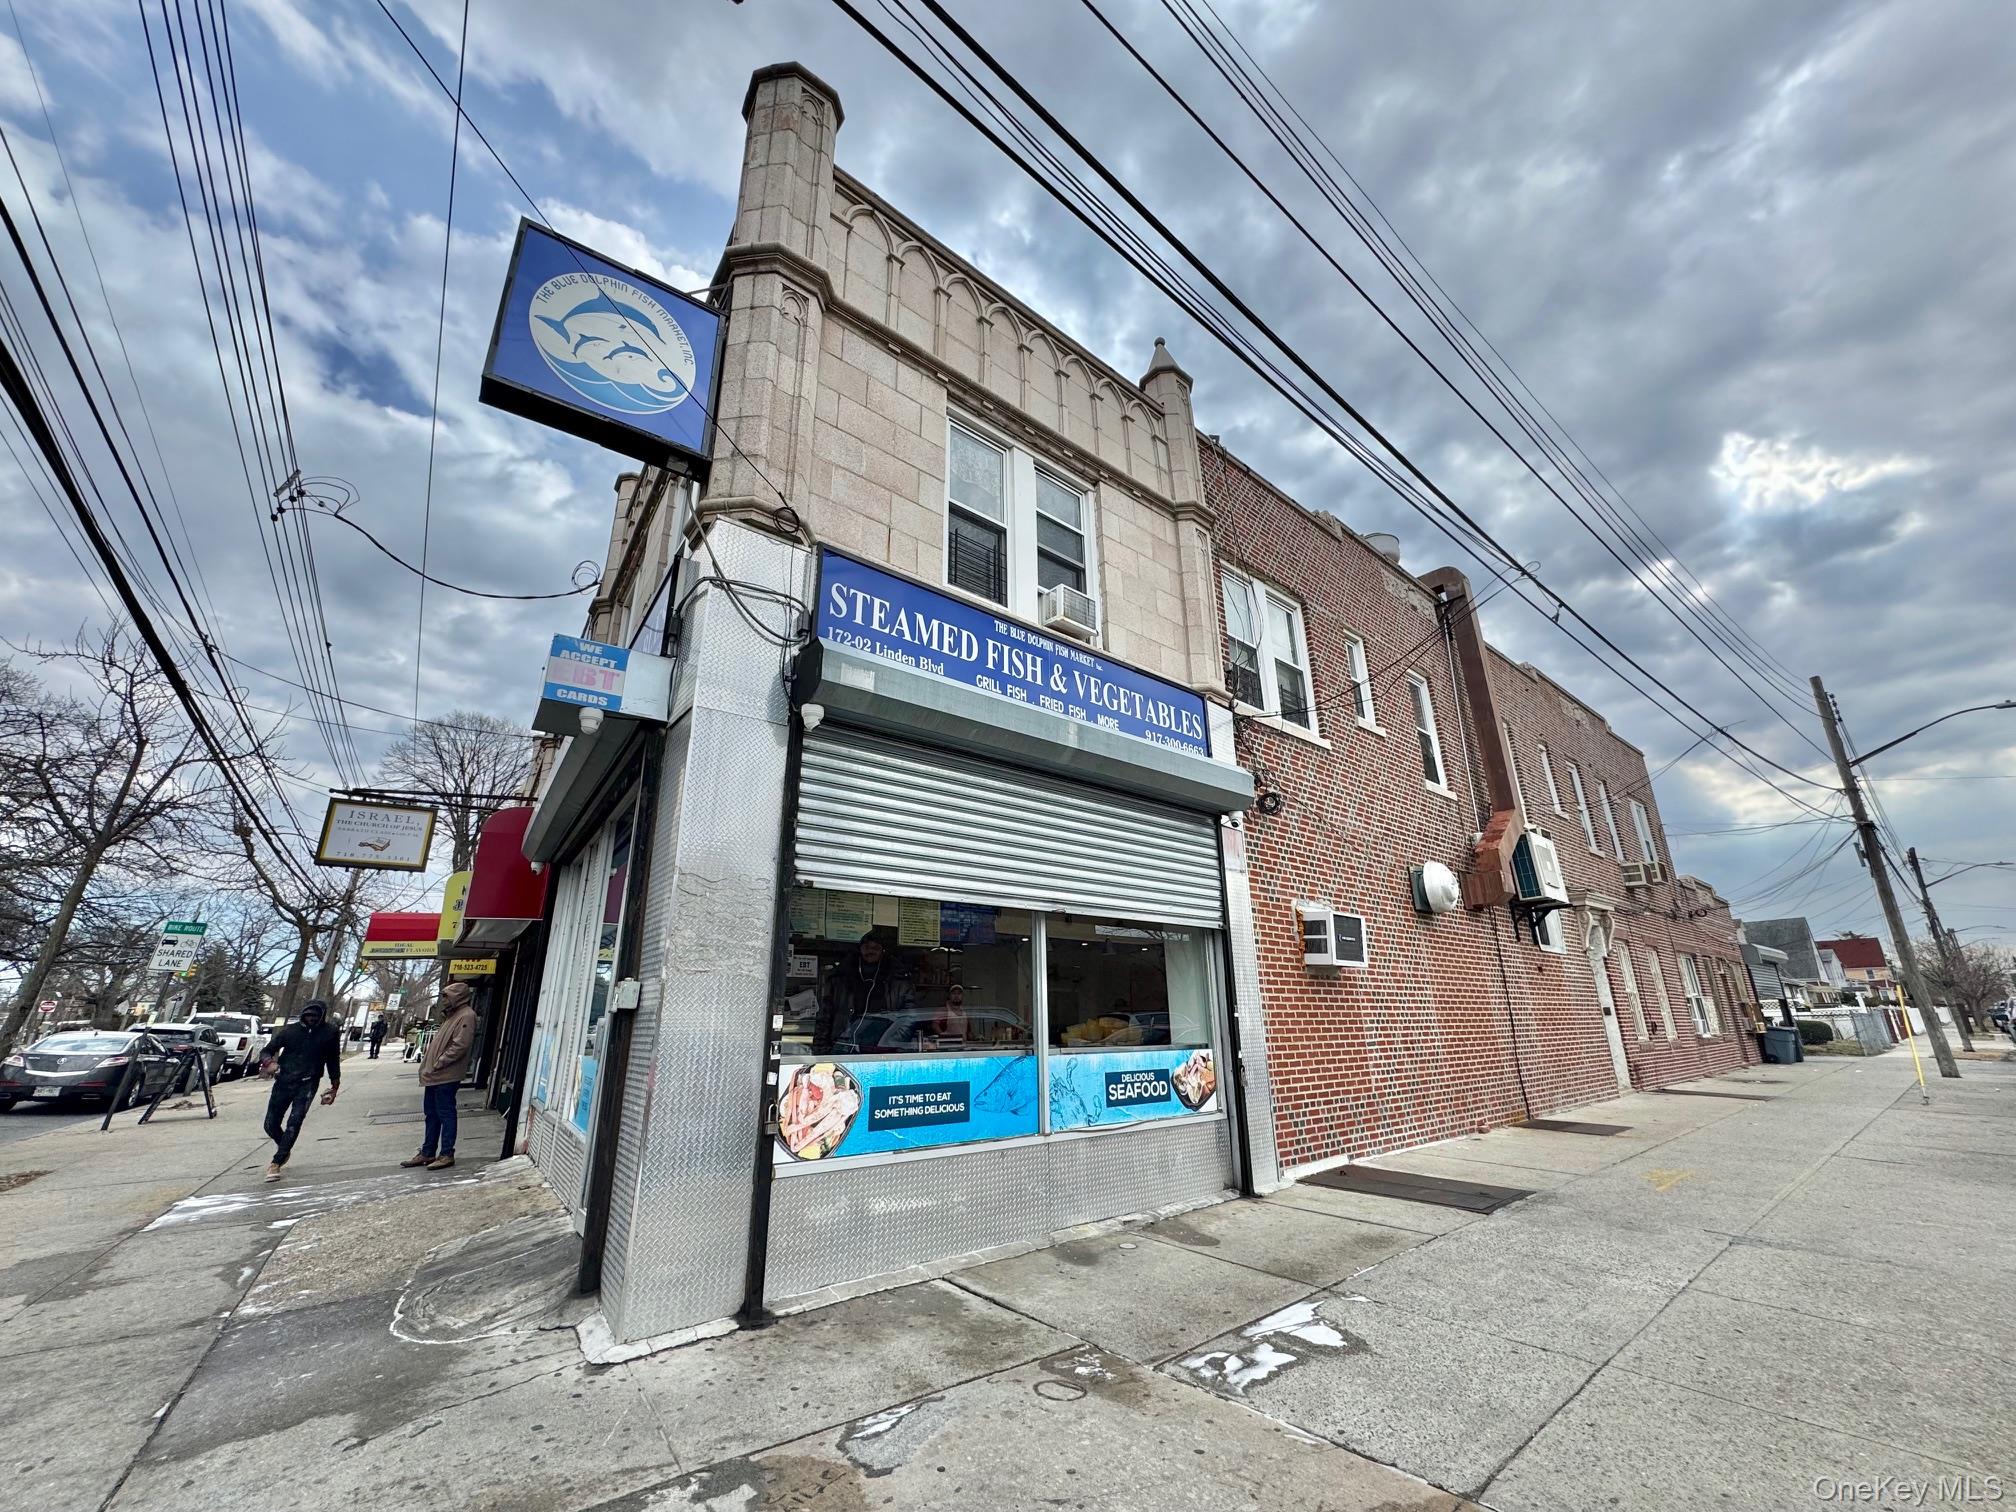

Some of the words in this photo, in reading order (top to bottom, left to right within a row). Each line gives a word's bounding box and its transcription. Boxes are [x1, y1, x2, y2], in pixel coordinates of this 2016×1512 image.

[535, 286, 555, 304] THE
[551, 274, 579, 290] BLUE
[580, 273, 628, 293] DOLPHIN
[632, 289, 657, 309] FISH
[579, 642, 604, 655] WE
[828, 626, 872, 653] 172-02
[875, 641, 916, 667] Linden
[919, 656, 944, 675] Blvd
[994, 620, 1008, 635] THE
[1010, 626, 1026, 642] BLUE
[1027, 631, 1054, 652] DOLPHIN
[1055, 642, 1069, 660] FISH
[1070, 649, 1095, 668] MARKET
[559, 649, 618, 669] ACCEPT
[829, 582, 978, 662] STEAMED
[985, 637, 1044, 686] FISH
[1049, 663, 1068, 694] &
[1073, 669, 1203, 740] VEGETABLES
[556, 688, 609, 706] CARDS
[976, 674, 1002, 694] GRILL
[1007, 684, 1027, 702] FISH
[1039, 694, 1064, 713] FRIED
[1068, 704, 1087, 721] FISH
[1097, 713, 1119, 731] MORE
[354, 821, 388, 829] CHURCH
[183, 924, 204, 932] ROUTE
[157, 949, 194, 959] SHARED
[158, 959, 184, 968] LANE
[1121, 1072, 1155, 1082] DELICIOUS
[888, 1095, 904, 1105] IT'S
[905, 1093, 924, 1104] TIME
[925, 1092, 936, 1102] TO
[937, 1092, 952, 1101] EAT
[1108, 1081, 1168, 1100] SEAFOOD
[874, 1106, 924, 1119] SOMETHING
[924, 1103, 965, 1114] DELICIOUS
